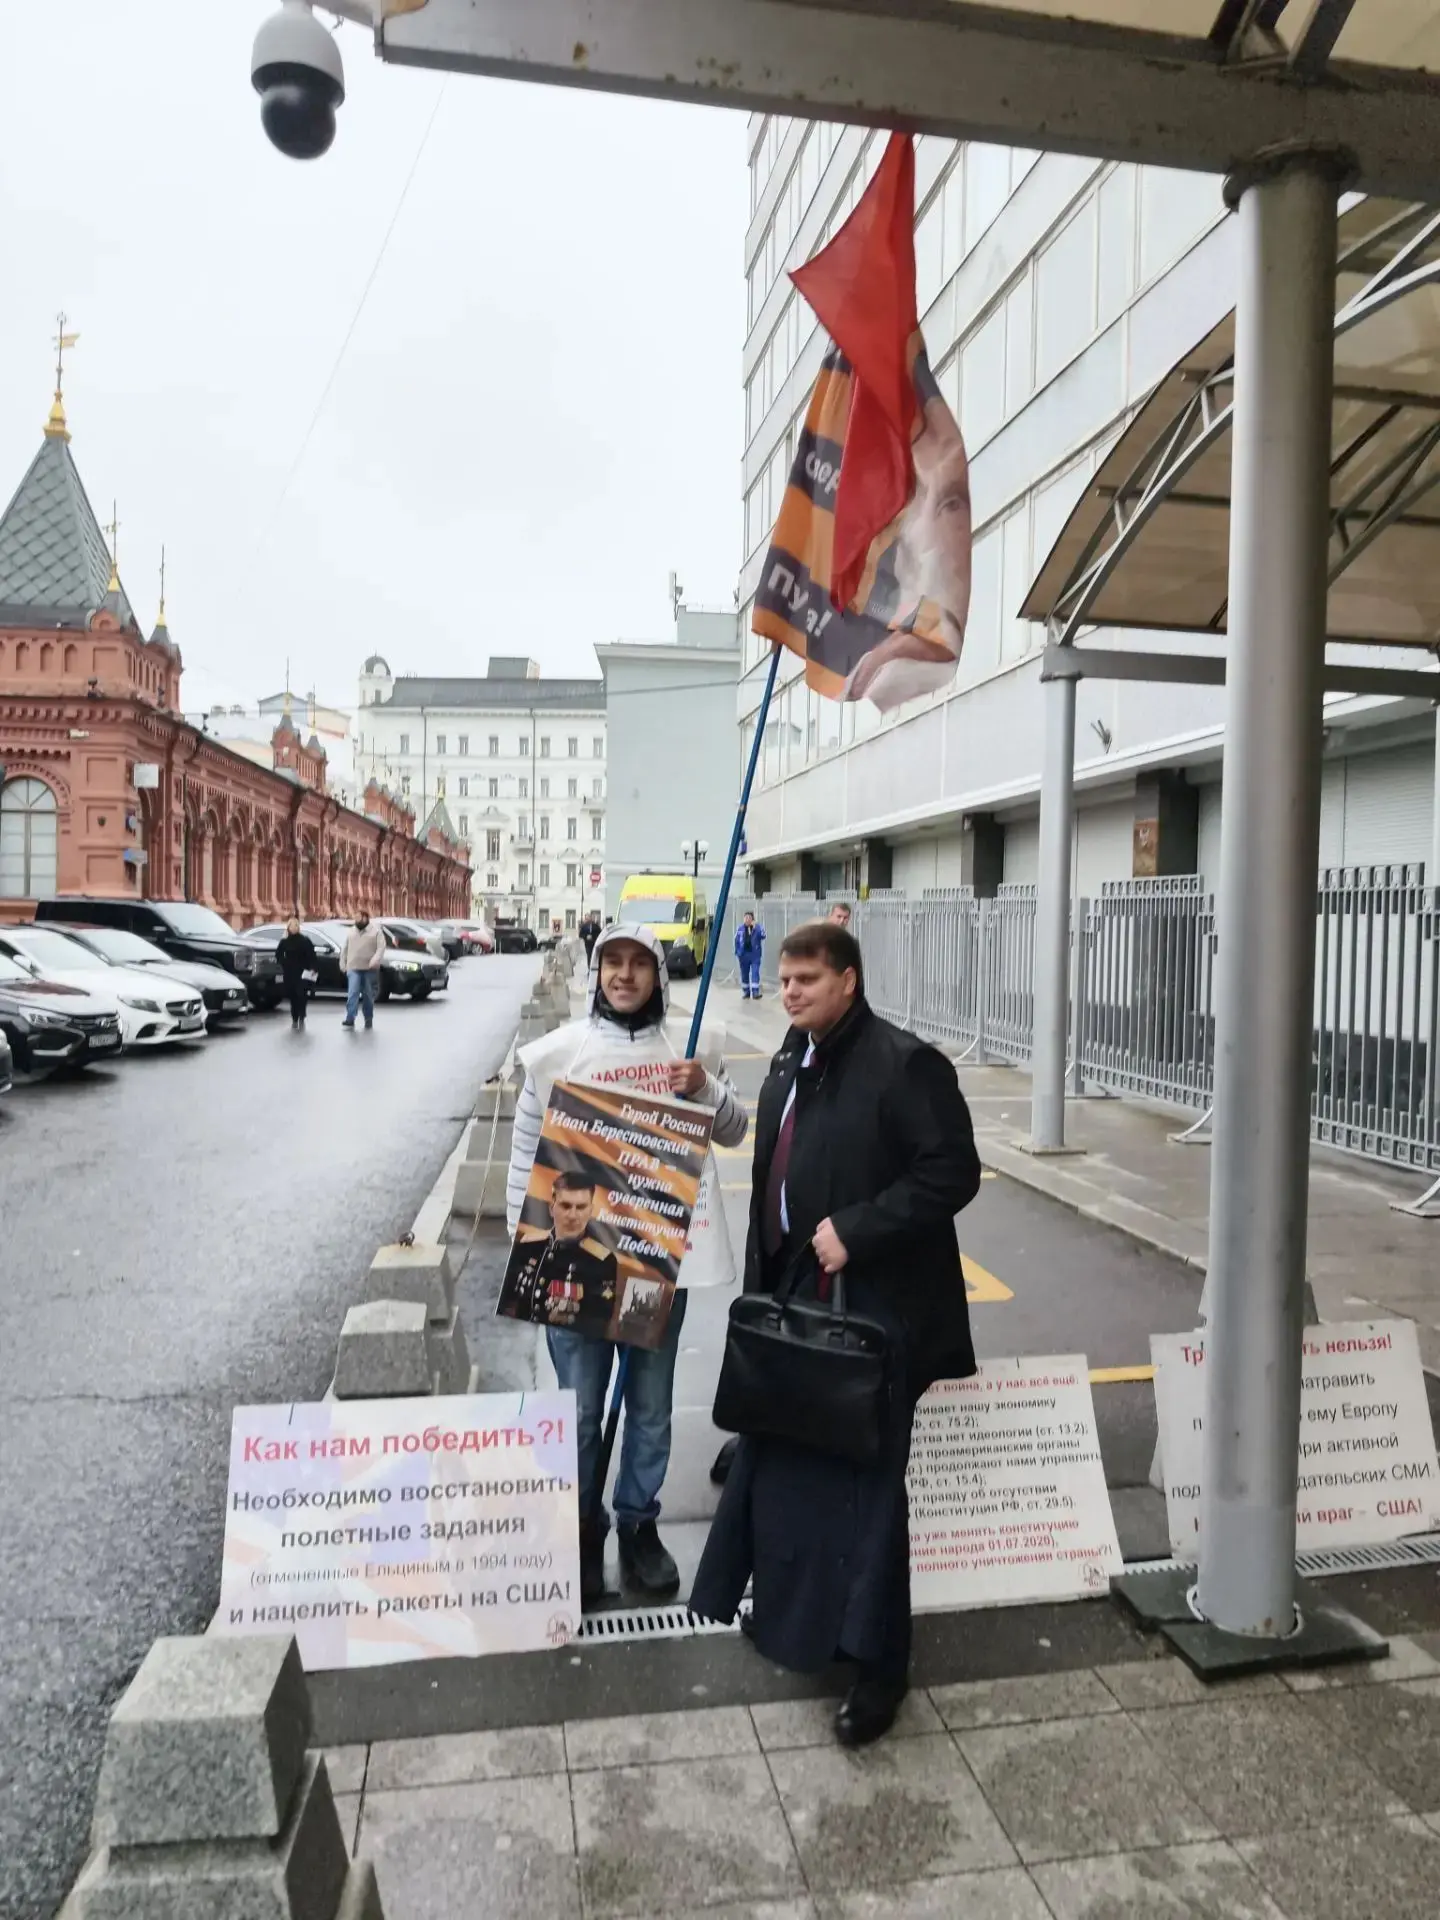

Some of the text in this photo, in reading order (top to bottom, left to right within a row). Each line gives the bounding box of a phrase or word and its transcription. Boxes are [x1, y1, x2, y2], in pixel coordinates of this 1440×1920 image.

[619, 1103, 706, 1137] Герой России
[550, 1109, 692, 1156] Иван Берестовский
[617, 1149, 660, 1170] ПРАВ
[627, 1173, 673, 1193] нужна
[607, 1190, 685, 1218] суверенная
[596, 1207, 687, 1239] Конституция
[617, 1234, 669, 1259] Победы
[1326, 1333, 1392, 1353] нельзя!
[915, 1397, 1056, 1416] бивает нашу экономику
[1341, 1402, 1399, 1420] Европу
[243, 1418, 565, 1463] Как нам победить?!
[946, 1433, 965, 1443] нет
[968, 1427, 1033, 1442] идеологии
[1327, 1433, 1400, 1453] активной
[926, 1443, 1033, 1461] проамериканские
[1036, 1438, 1080, 1453] органы
[926, 1459, 1002, 1476] продолжают
[1006, 1456, 1037, 1468] нами
[231, 1473, 572, 1512] Необходимо восстановить
[922, 1491, 967, 1506] правду
[970, 1488, 986, 1500] об
[989, 1483, 1058, 1499] отсутствии
[1317, 1507, 1353, 1524] враг
[1376, 1497, 1423, 1517] США!
[280, 1514, 526, 1549] полетные задания
[924, 1531, 948, 1545] уже
[951, 1526, 996, 1540] менять
[999, 1519, 1079, 1535] конституцию
[940, 1542, 985, 1557] народа
[364, 1558, 451, 1581] Ельциным
[455, 1561, 464, 1573] в
[471, 1553, 508, 1572] 1994
[512, 1550, 554, 1571] году)
[916, 1560, 969, 1574] полного
[971, 1552, 1054, 1570] уничтожения
[229, 1580, 572, 1625] и нацелить ракеты на США!
